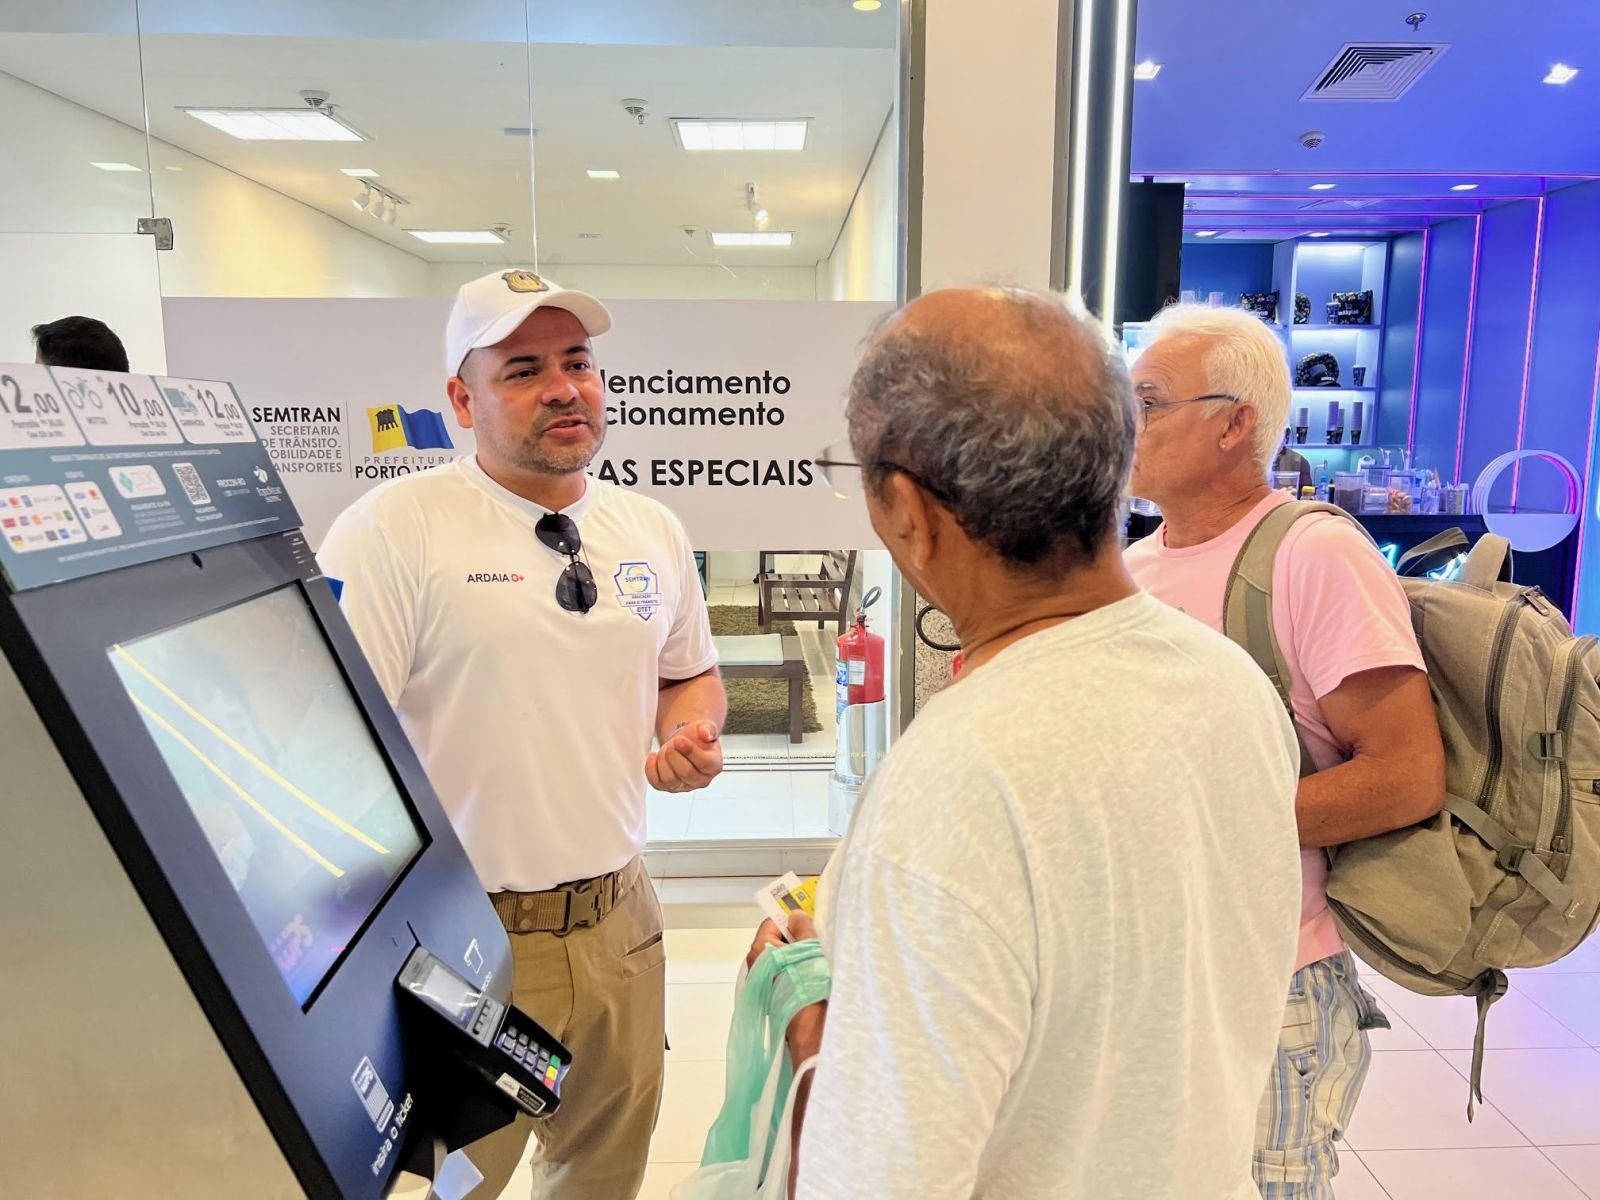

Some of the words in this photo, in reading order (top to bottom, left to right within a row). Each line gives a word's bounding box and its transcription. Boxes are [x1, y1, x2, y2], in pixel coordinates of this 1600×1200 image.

[107, 381, 163, 419] 10,00
[197, 388, 240, 420] 12,00
[252, 407, 341, 423] SEMTRAN
[605, 400, 785, 426] cionamento
[270, 425, 340, 436] SECRETARIA
[270, 450, 332, 459] OBILIDADE
[335, 450, 342, 459] E
[274, 462, 343, 473] ANSPORTES
[355, 465, 411, 479] PORTO
[590, 459, 639, 486] AS
[651, 459, 813, 487] ESPECIAIS
[467, 573, 510, 583] ARDAIA
